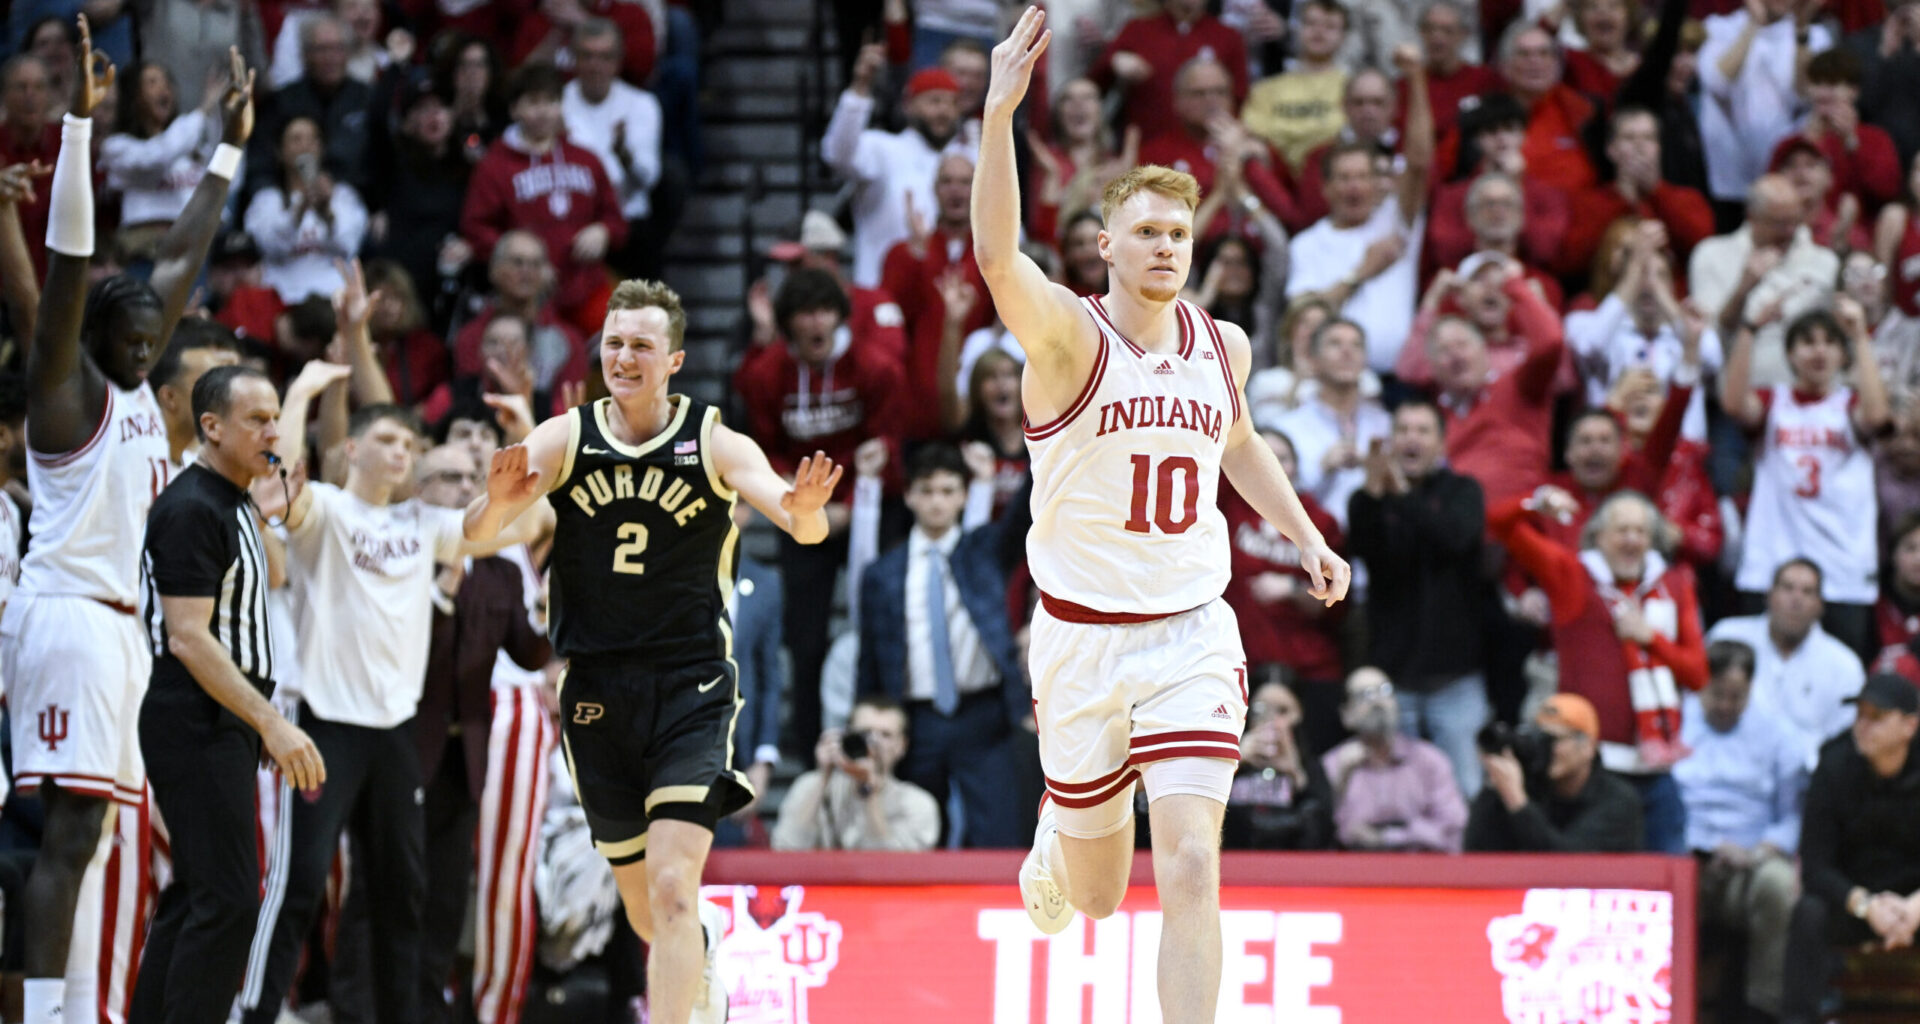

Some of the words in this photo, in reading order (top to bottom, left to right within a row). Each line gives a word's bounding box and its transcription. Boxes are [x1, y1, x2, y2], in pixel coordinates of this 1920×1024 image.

[1096, 396, 1222, 444] INDIANA
[569, 464, 707, 528] PURDUE
[1124, 453, 1199, 535] 10
[1795, 454, 1821, 499] 3
[612, 521, 649, 575] 2
[573, 702, 604, 725] P
